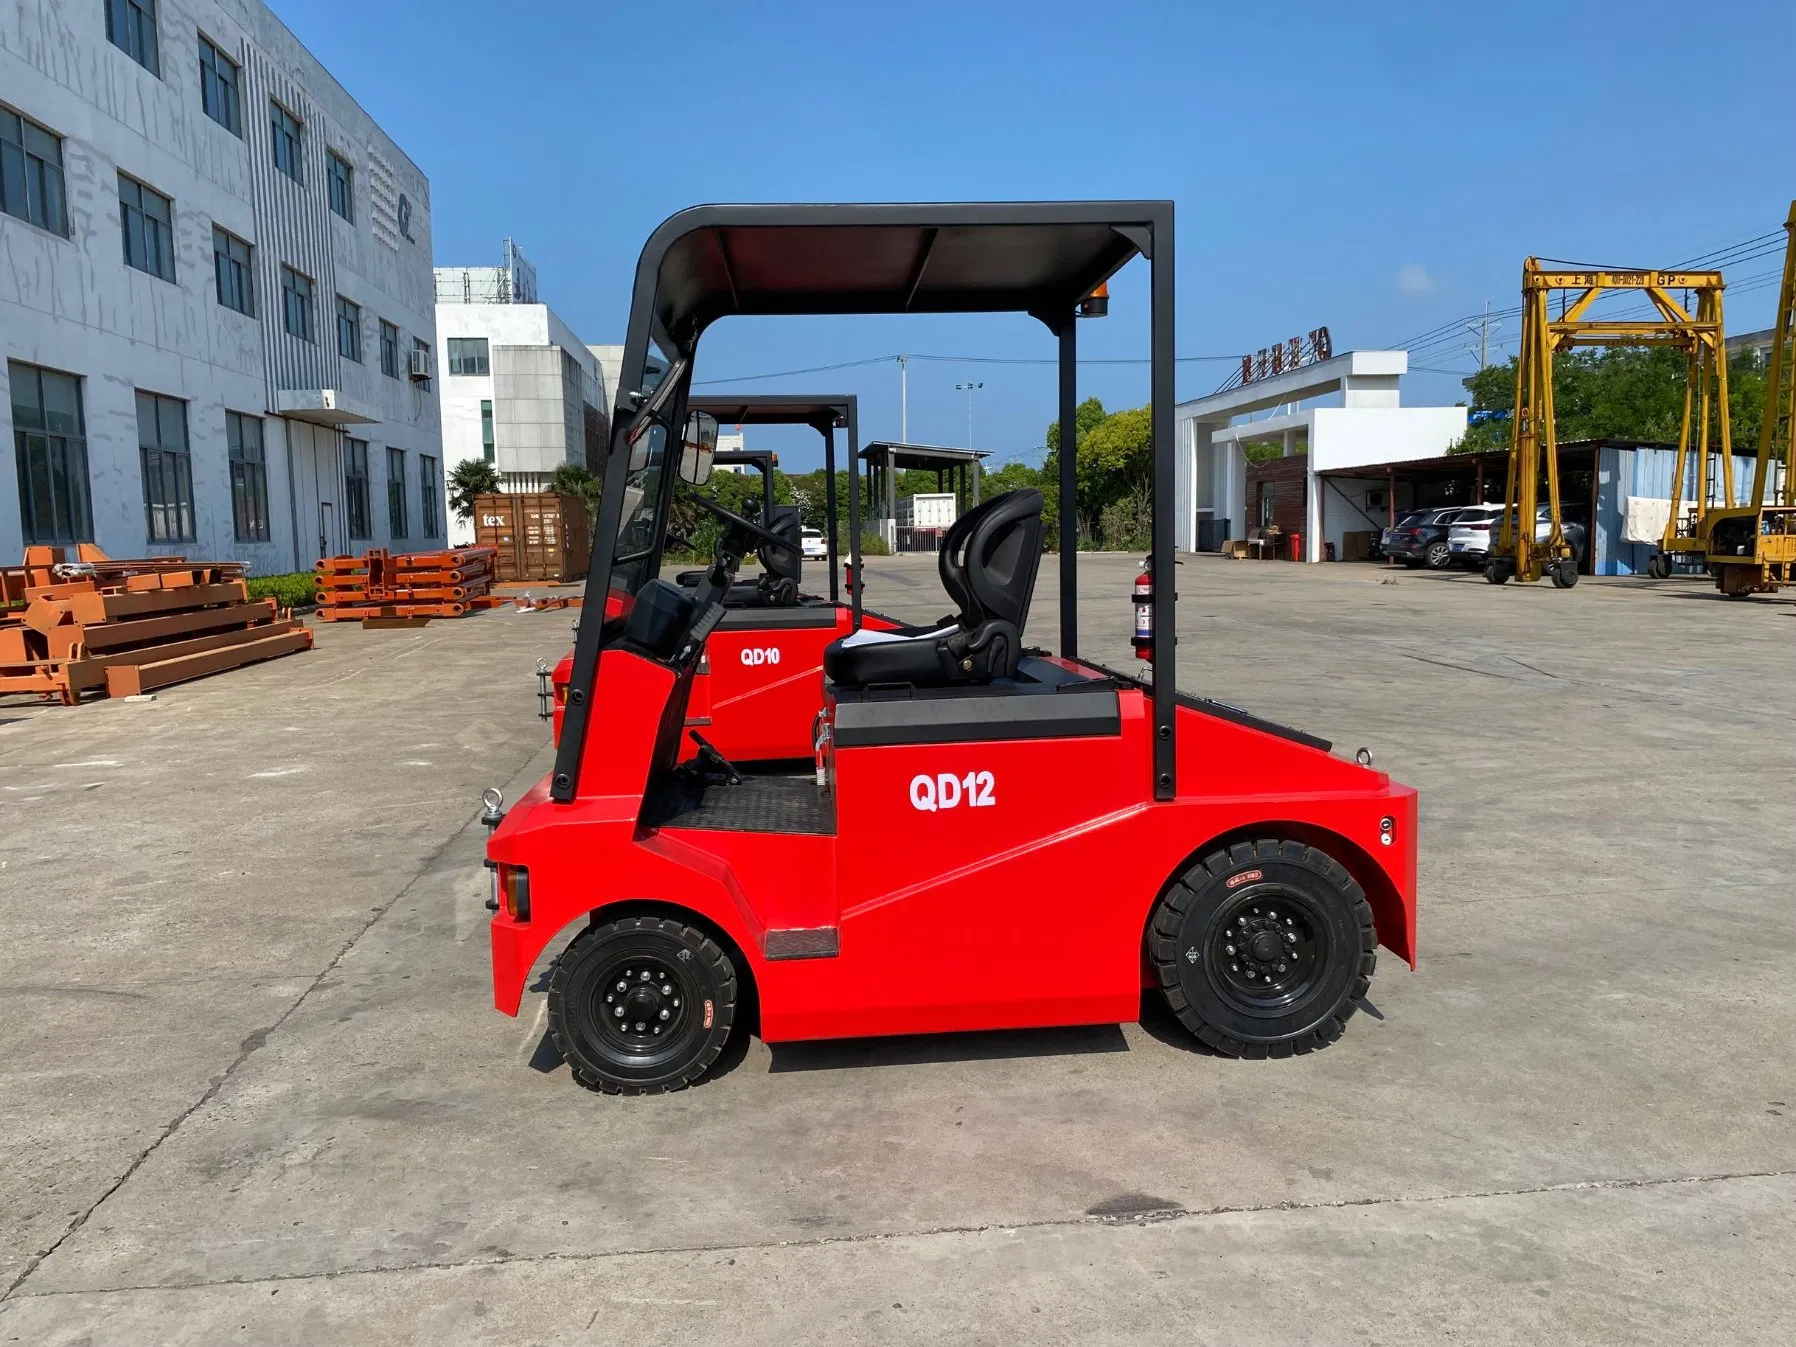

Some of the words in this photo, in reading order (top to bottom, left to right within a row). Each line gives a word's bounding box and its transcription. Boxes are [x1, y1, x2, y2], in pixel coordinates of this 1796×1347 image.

[1571, 272, 1594, 286] 上海
[1657, 274, 1676, 286] GP
[482, 513, 506, 527] tex
[740, 647, 780, 667] QD10
[909, 770, 996, 813] QD12
